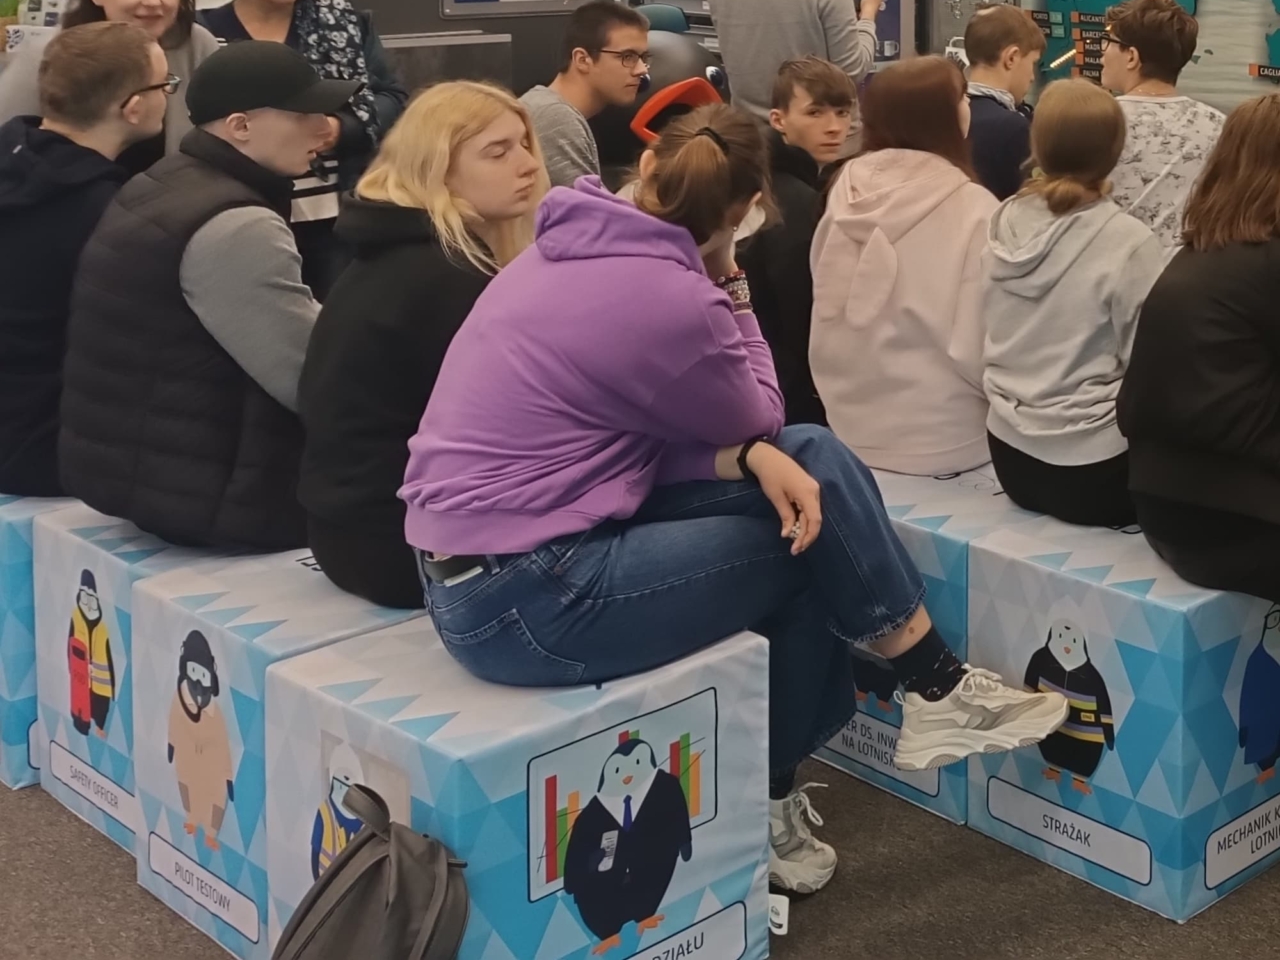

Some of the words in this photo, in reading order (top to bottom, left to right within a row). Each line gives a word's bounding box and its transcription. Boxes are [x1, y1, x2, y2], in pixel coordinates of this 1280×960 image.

[70, 765, 91, 789] SAFETY
[93, 781, 119, 809] OFFICER
[1043, 814, 1090, 847] STRAŻAK
[1217, 810, 1272, 854] MECHANIK
[175, 862, 194, 886] PILOT
[196, 877, 231, 912] TESTOWY
